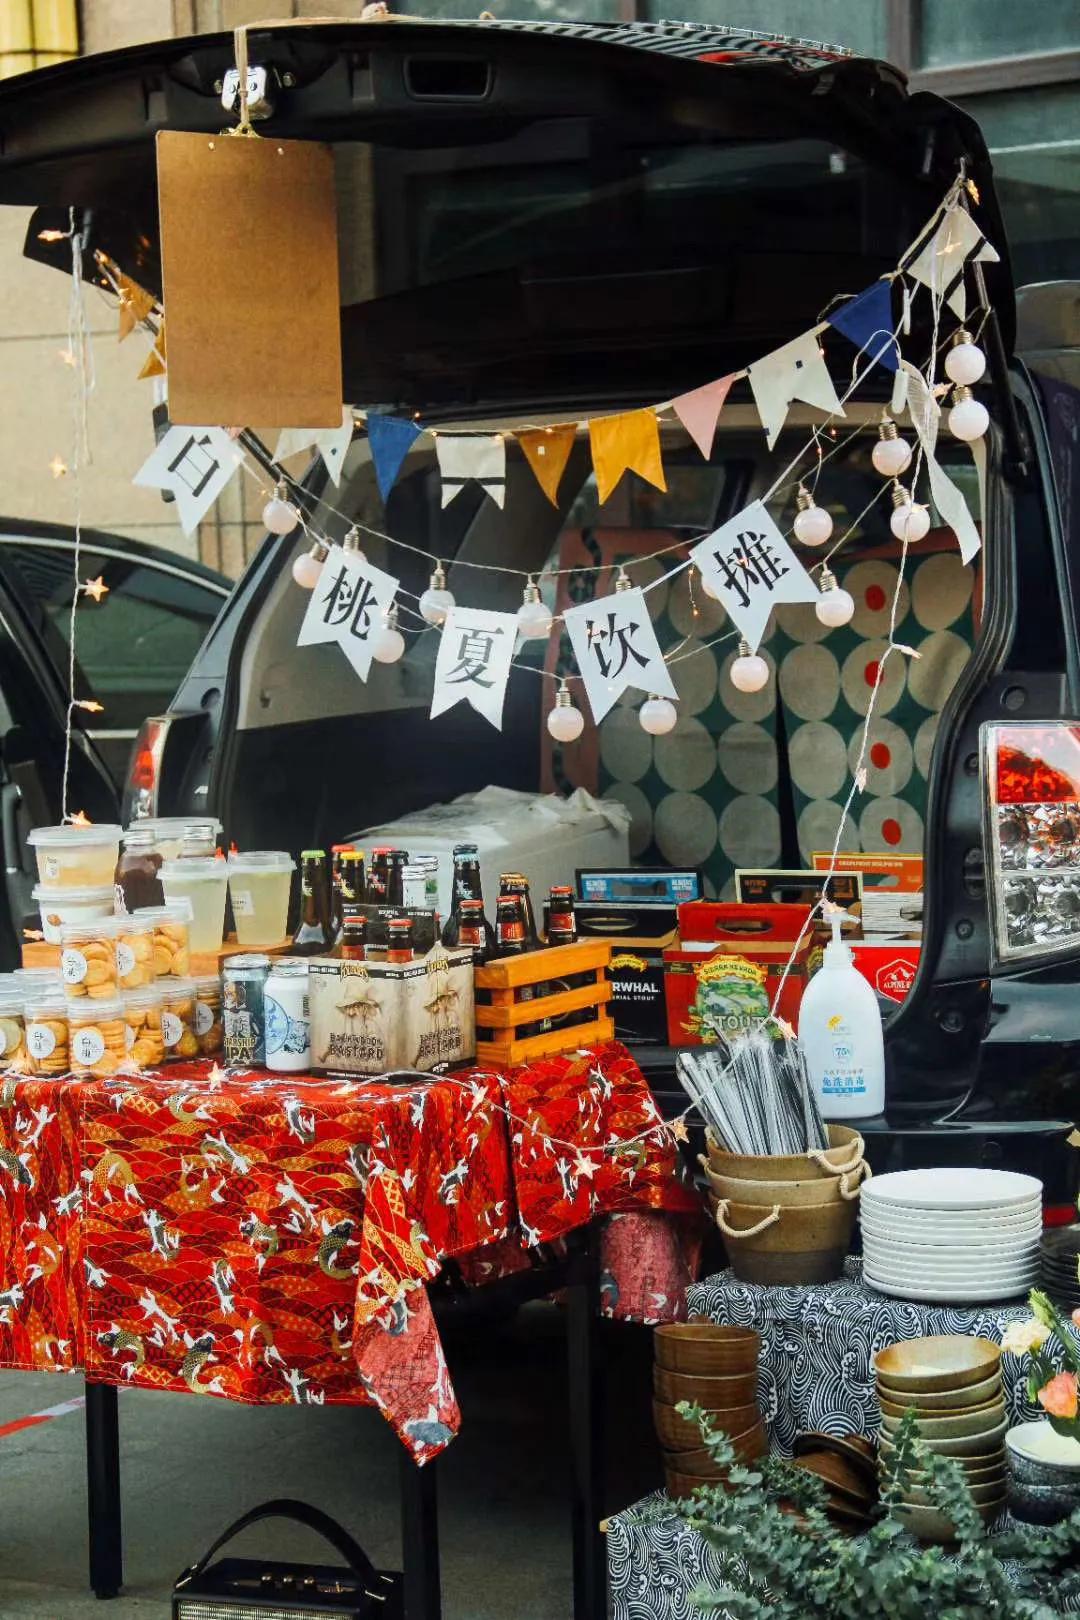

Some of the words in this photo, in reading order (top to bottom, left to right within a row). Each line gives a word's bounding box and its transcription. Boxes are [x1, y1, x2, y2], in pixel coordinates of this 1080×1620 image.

[168, 435, 220, 497] 白
[322, 564, 379, 641] 桃
[445, 626, 505, 689] 夏
[586, 612, 651, 679] 饮
[711, 530, 790, 608] 摊
[703, 1014, 766, 1030] STOUT
[330, 1045, 384, 1060] BASTARD
